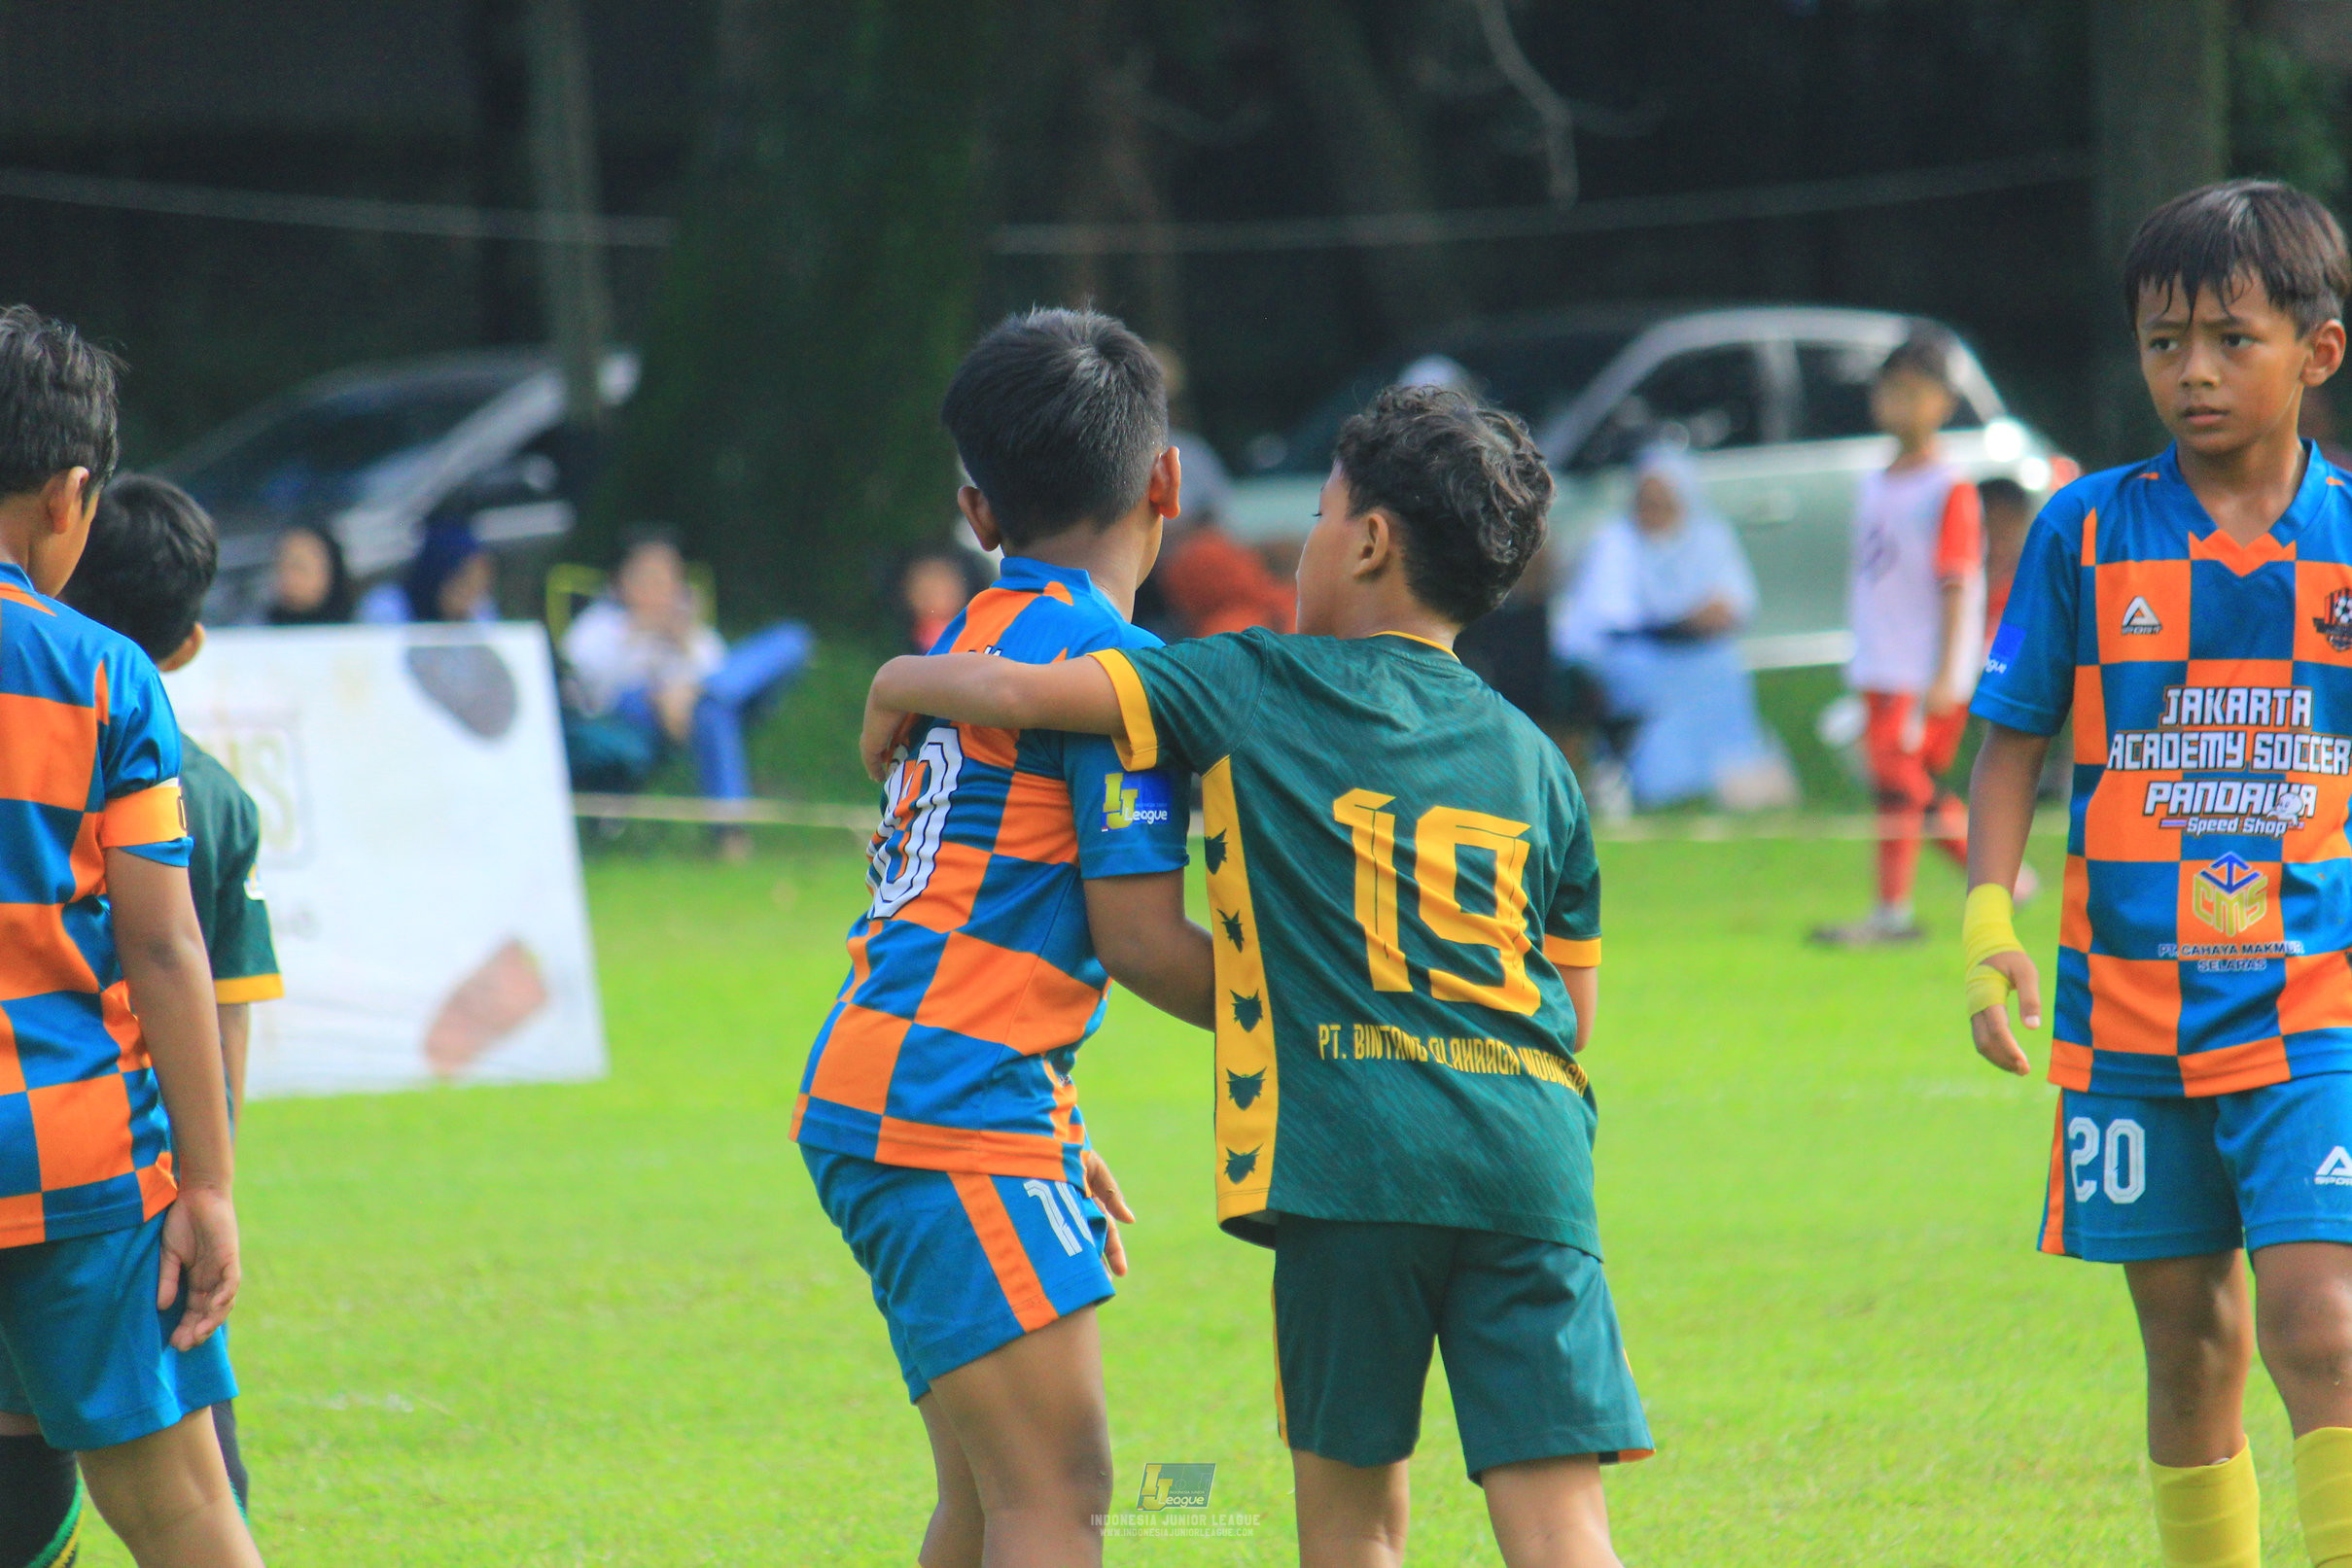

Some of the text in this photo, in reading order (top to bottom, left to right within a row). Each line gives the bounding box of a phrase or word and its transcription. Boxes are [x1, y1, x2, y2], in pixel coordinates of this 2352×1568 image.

[2161, 687, 2313, 727] JAKARTA
[2107, 731, 2352, 776] ACADEMY SOCCER
[1124, 808, 1168, 824] League
[2187, 817, 2288, 838] Speed Shop
[1333, 788, 1541, 1017] 19
[2194, 874, 2268, 937] CMS
[2181, 943, 2237, 956] CAHAYA
[1318, 1024, 1347, 1061] PT.
[1353, 1024, 1428, 1062] BINTANG
[2068, 1117, 2145, 1204] 20
